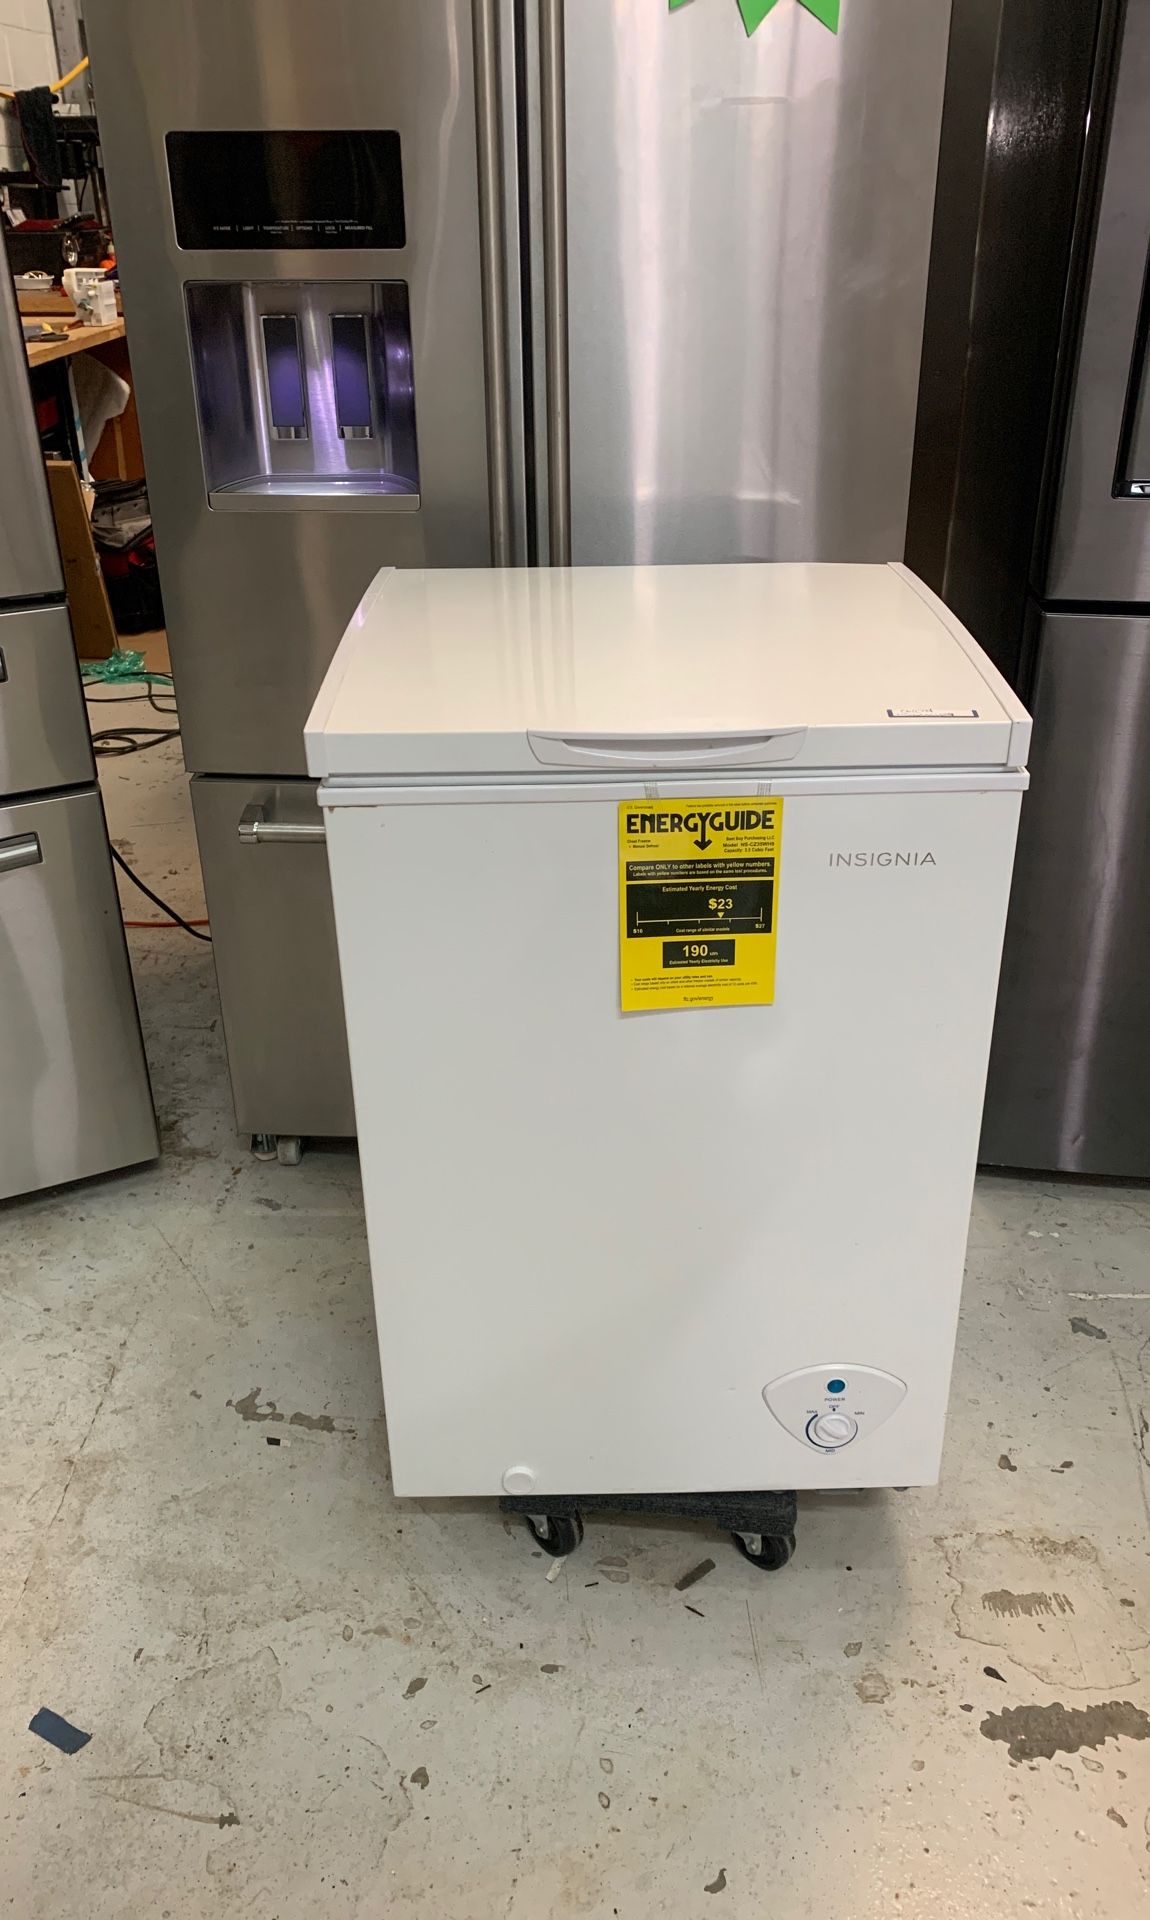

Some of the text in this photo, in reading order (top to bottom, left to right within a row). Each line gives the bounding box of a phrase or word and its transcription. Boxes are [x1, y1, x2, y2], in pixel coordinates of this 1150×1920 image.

[627, 810, 775, 834] ENERGYGUIDE
[829, 852, 937, 867] INSIGNIA
[708, 898, 733, 910] $23
[682, 944, 708, 957] 190
